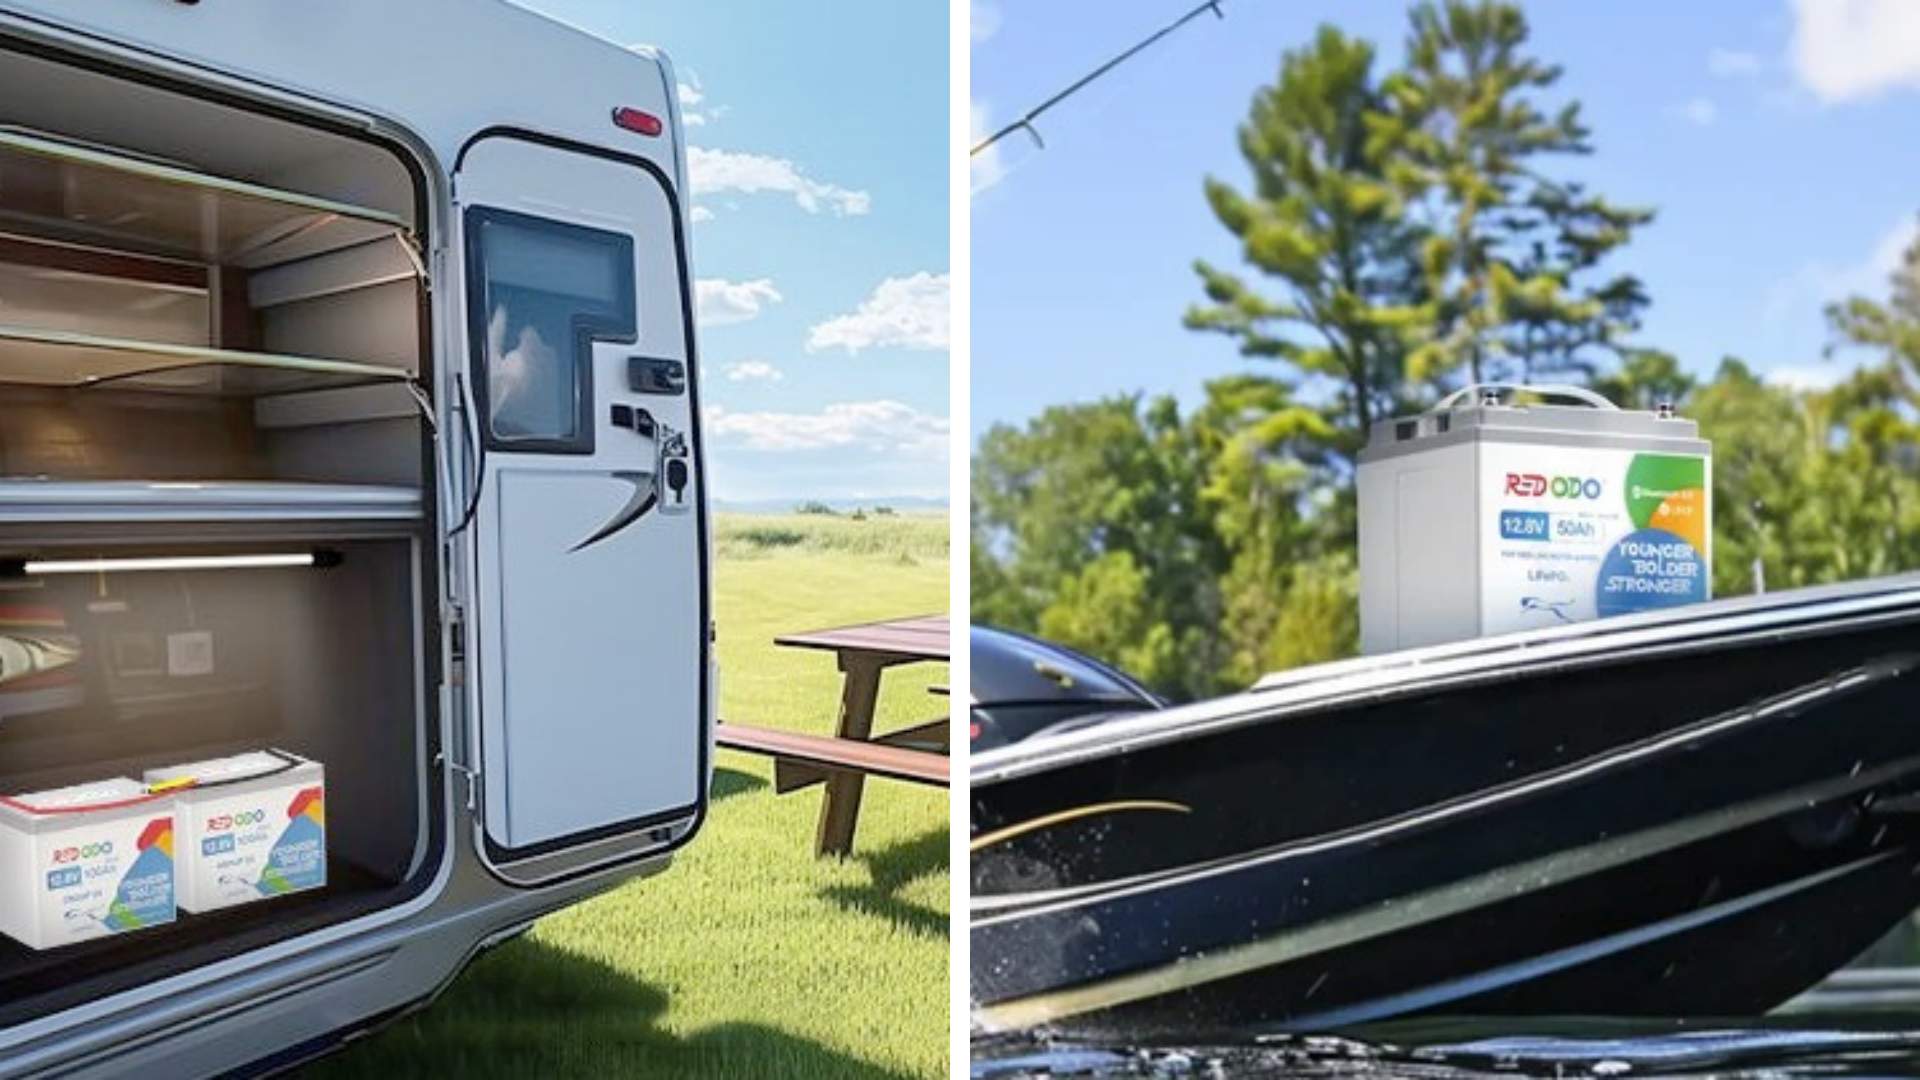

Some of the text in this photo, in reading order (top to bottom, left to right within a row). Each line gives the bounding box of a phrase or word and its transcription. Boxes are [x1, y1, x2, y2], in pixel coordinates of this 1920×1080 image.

[1503, 518, 1596, 536] 12.8V 50Ah
[1619, 542, 1694, 561] YOUNGER
[1632, 559, 1698, 578] BOLDER
[1604, 575, 1692, 594] STRONGER
